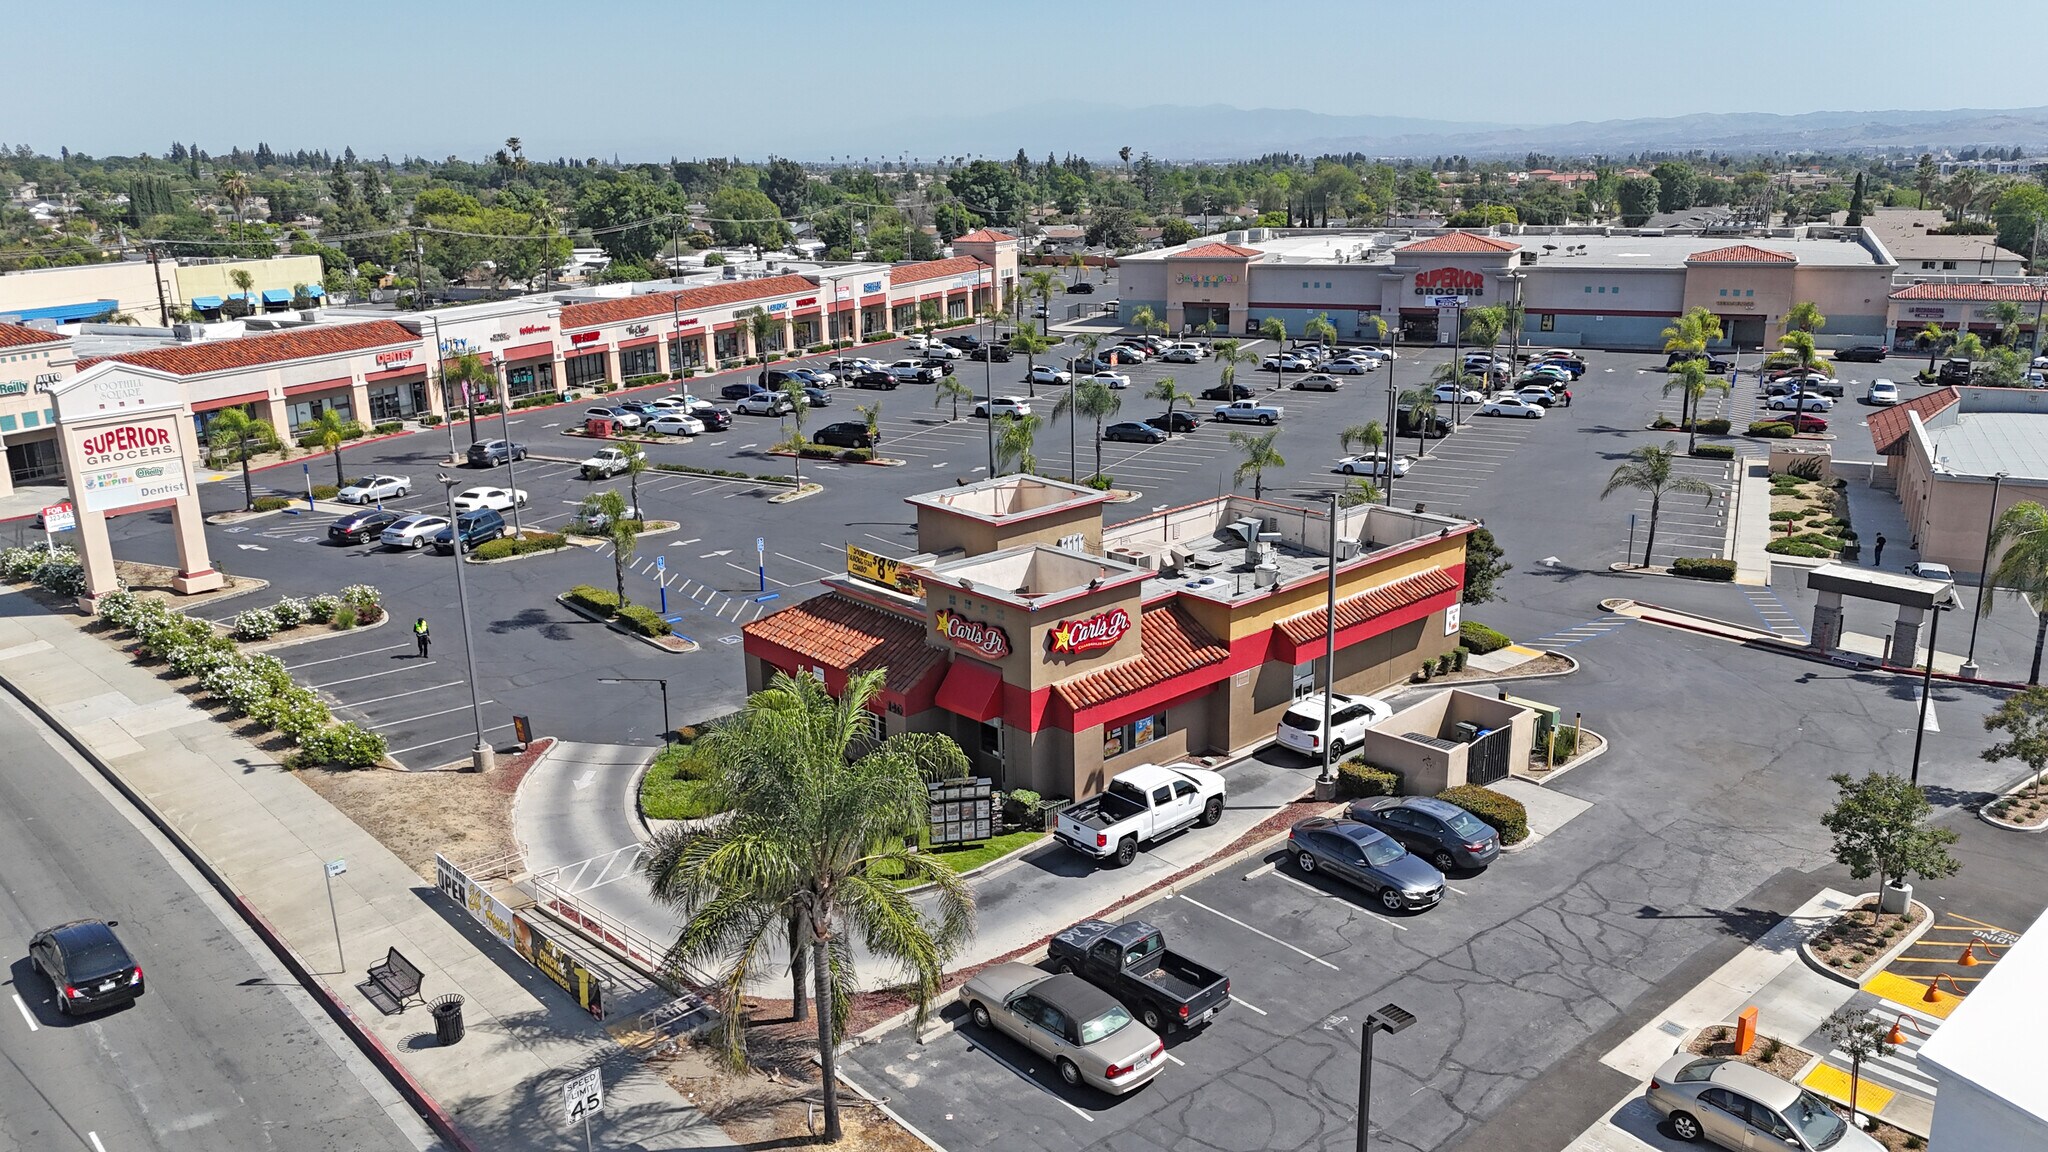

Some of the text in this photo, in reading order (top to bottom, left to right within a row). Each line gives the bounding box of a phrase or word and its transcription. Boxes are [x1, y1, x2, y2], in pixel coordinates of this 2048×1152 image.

[1415, 267, 1484, 288] SUPERIOR
[1415, 288, 1483, 296] GROCERS
[376, 349, 414, 364] DENTIST
[37, 372, 62, 383] AUTO
[94, 379, 143, 391] FOOTHILL
[100, 388, 142, 400] SQUARE
[83, 427, 170, 456] SUPERIOR
[97, 472, 118, 481] KIDS
[98, 477, 134, 488] EMPIRE
[141, 482, 184, 496] Dentist
[46, 507, 63, 515] FOR
[947, 618, 1006, 654] Carl's Jr.
[1069, 612, 1130, 646] Carl's Jr.
[438, 868, 467, 907] OPEN
[468, 884, 481, 913] 24
[567, 1074, 595, 1091] SPEED
[572, 1084, 593, 1099] LIMIT
[571, 1093, 600, 1118] 45
